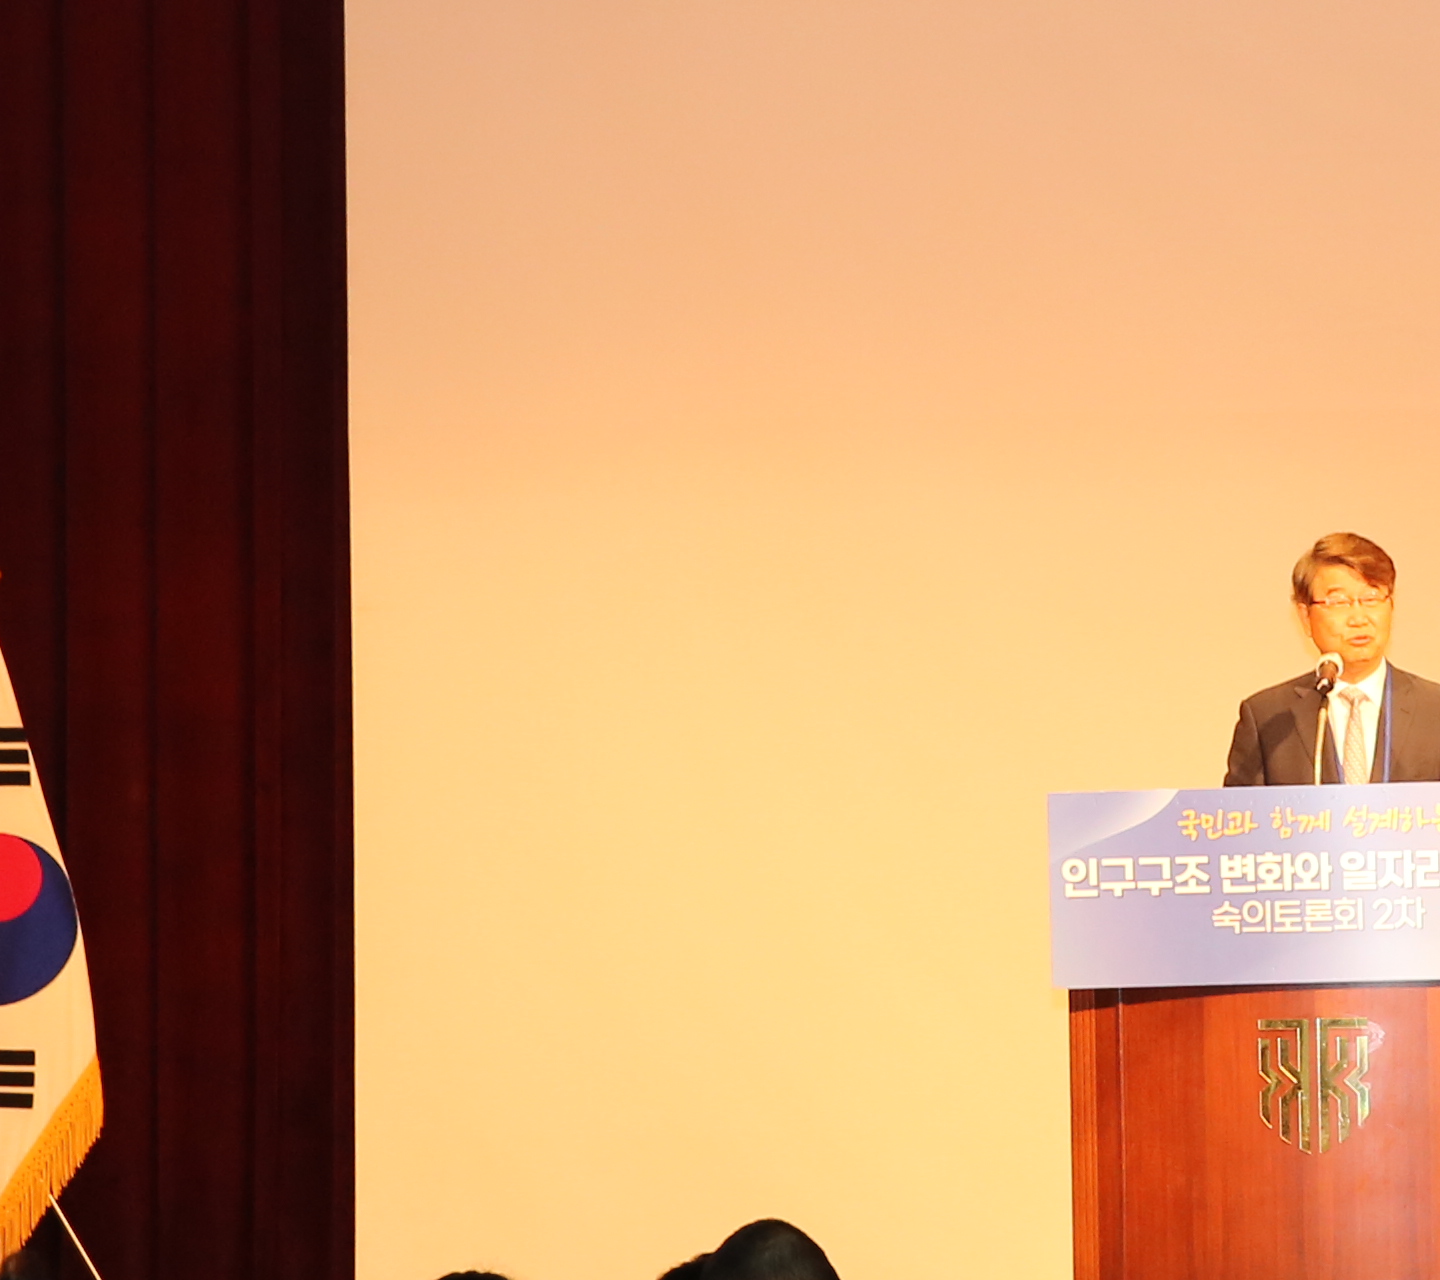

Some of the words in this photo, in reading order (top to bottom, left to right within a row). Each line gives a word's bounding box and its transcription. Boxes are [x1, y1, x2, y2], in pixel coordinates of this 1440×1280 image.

[1177, 808, 1259, 841] 국민과
[1269, 805, 1332, 839] 함께
[1061, 854, 1211, 898] 인구구조
[1219, 851, 1333, 894] 변화와
[1211, 896, 1365, 934] 숙의토론회
[1372, 895, 1427, 931] 2차
